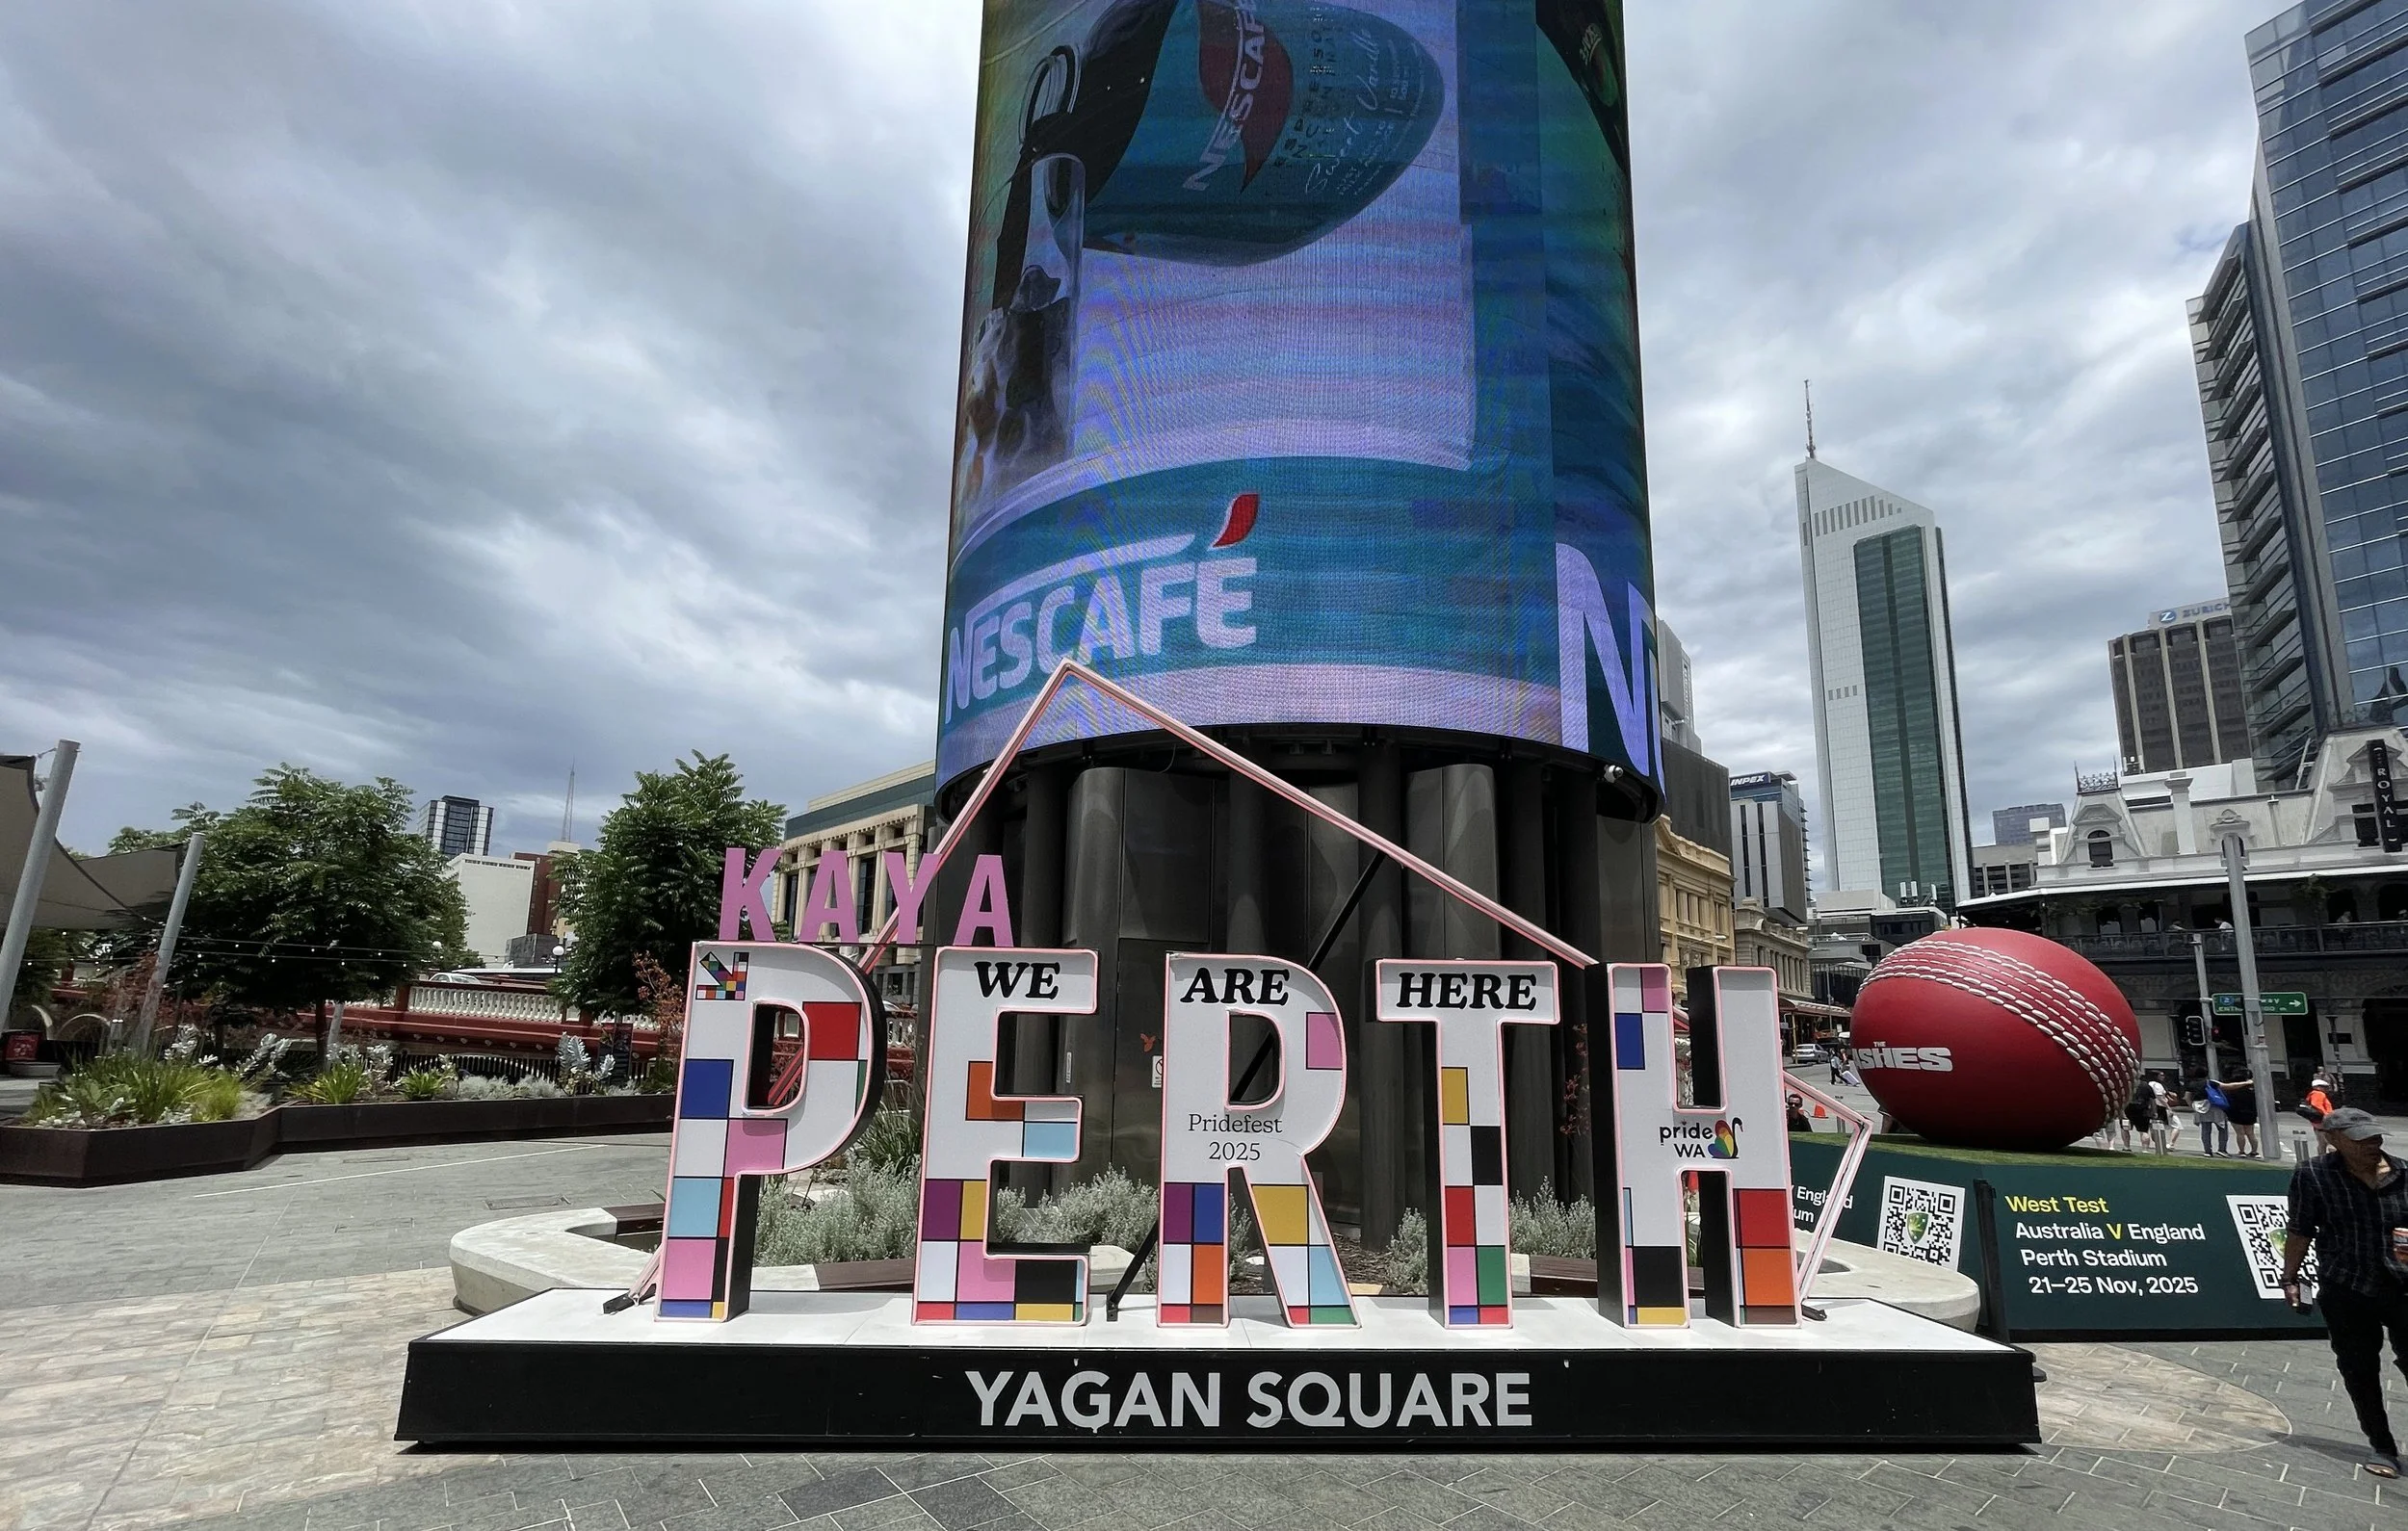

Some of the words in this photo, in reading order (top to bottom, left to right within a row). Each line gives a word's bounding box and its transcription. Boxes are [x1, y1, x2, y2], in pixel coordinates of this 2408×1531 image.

[945, 492, 1260, 724] NESCAFÉ
[1730, 774, 1766, 787] INPEX
[2377, 767, 2396, 828] ROYAL
[719, 847, 1013, 947] KAYA
[974, 961, 1060, 999] WE
[1180, 967, 1290, 1006] ARE
[1397, 972, 1538, 1010] HERE
[654, 940, 1802, 1328] PERTH
[1188, 1113, 1283, 1133] Pridefest
[1659, 1120, 1714, 1146] pride
[1209, 1141, 1261, 1161] 2025
[1674, 1143, 1706, 1158] WA
[1796, 1185, 1854, 1209] Engld
[2004, 1195, 2061, 1213] West
[2062, 1196, 2109, 1213] Test
[2015, 1222, 2105, 1240] Australia
[2107, 1223, 2122, 1240] V
[2127, 1223, 2207, 1245] England
[2021, 1249, 2080, 1266] Perth
[2082, 1249, 2167, 1266] Stadium
[2096, 1276, 2144, 1296] Nov,
[2146, 1276, 2199, 1294] 2025
[965, 1370, 1220, 1431] YAGAN
[1245, 1371, 1532, 1429] SQUARE
